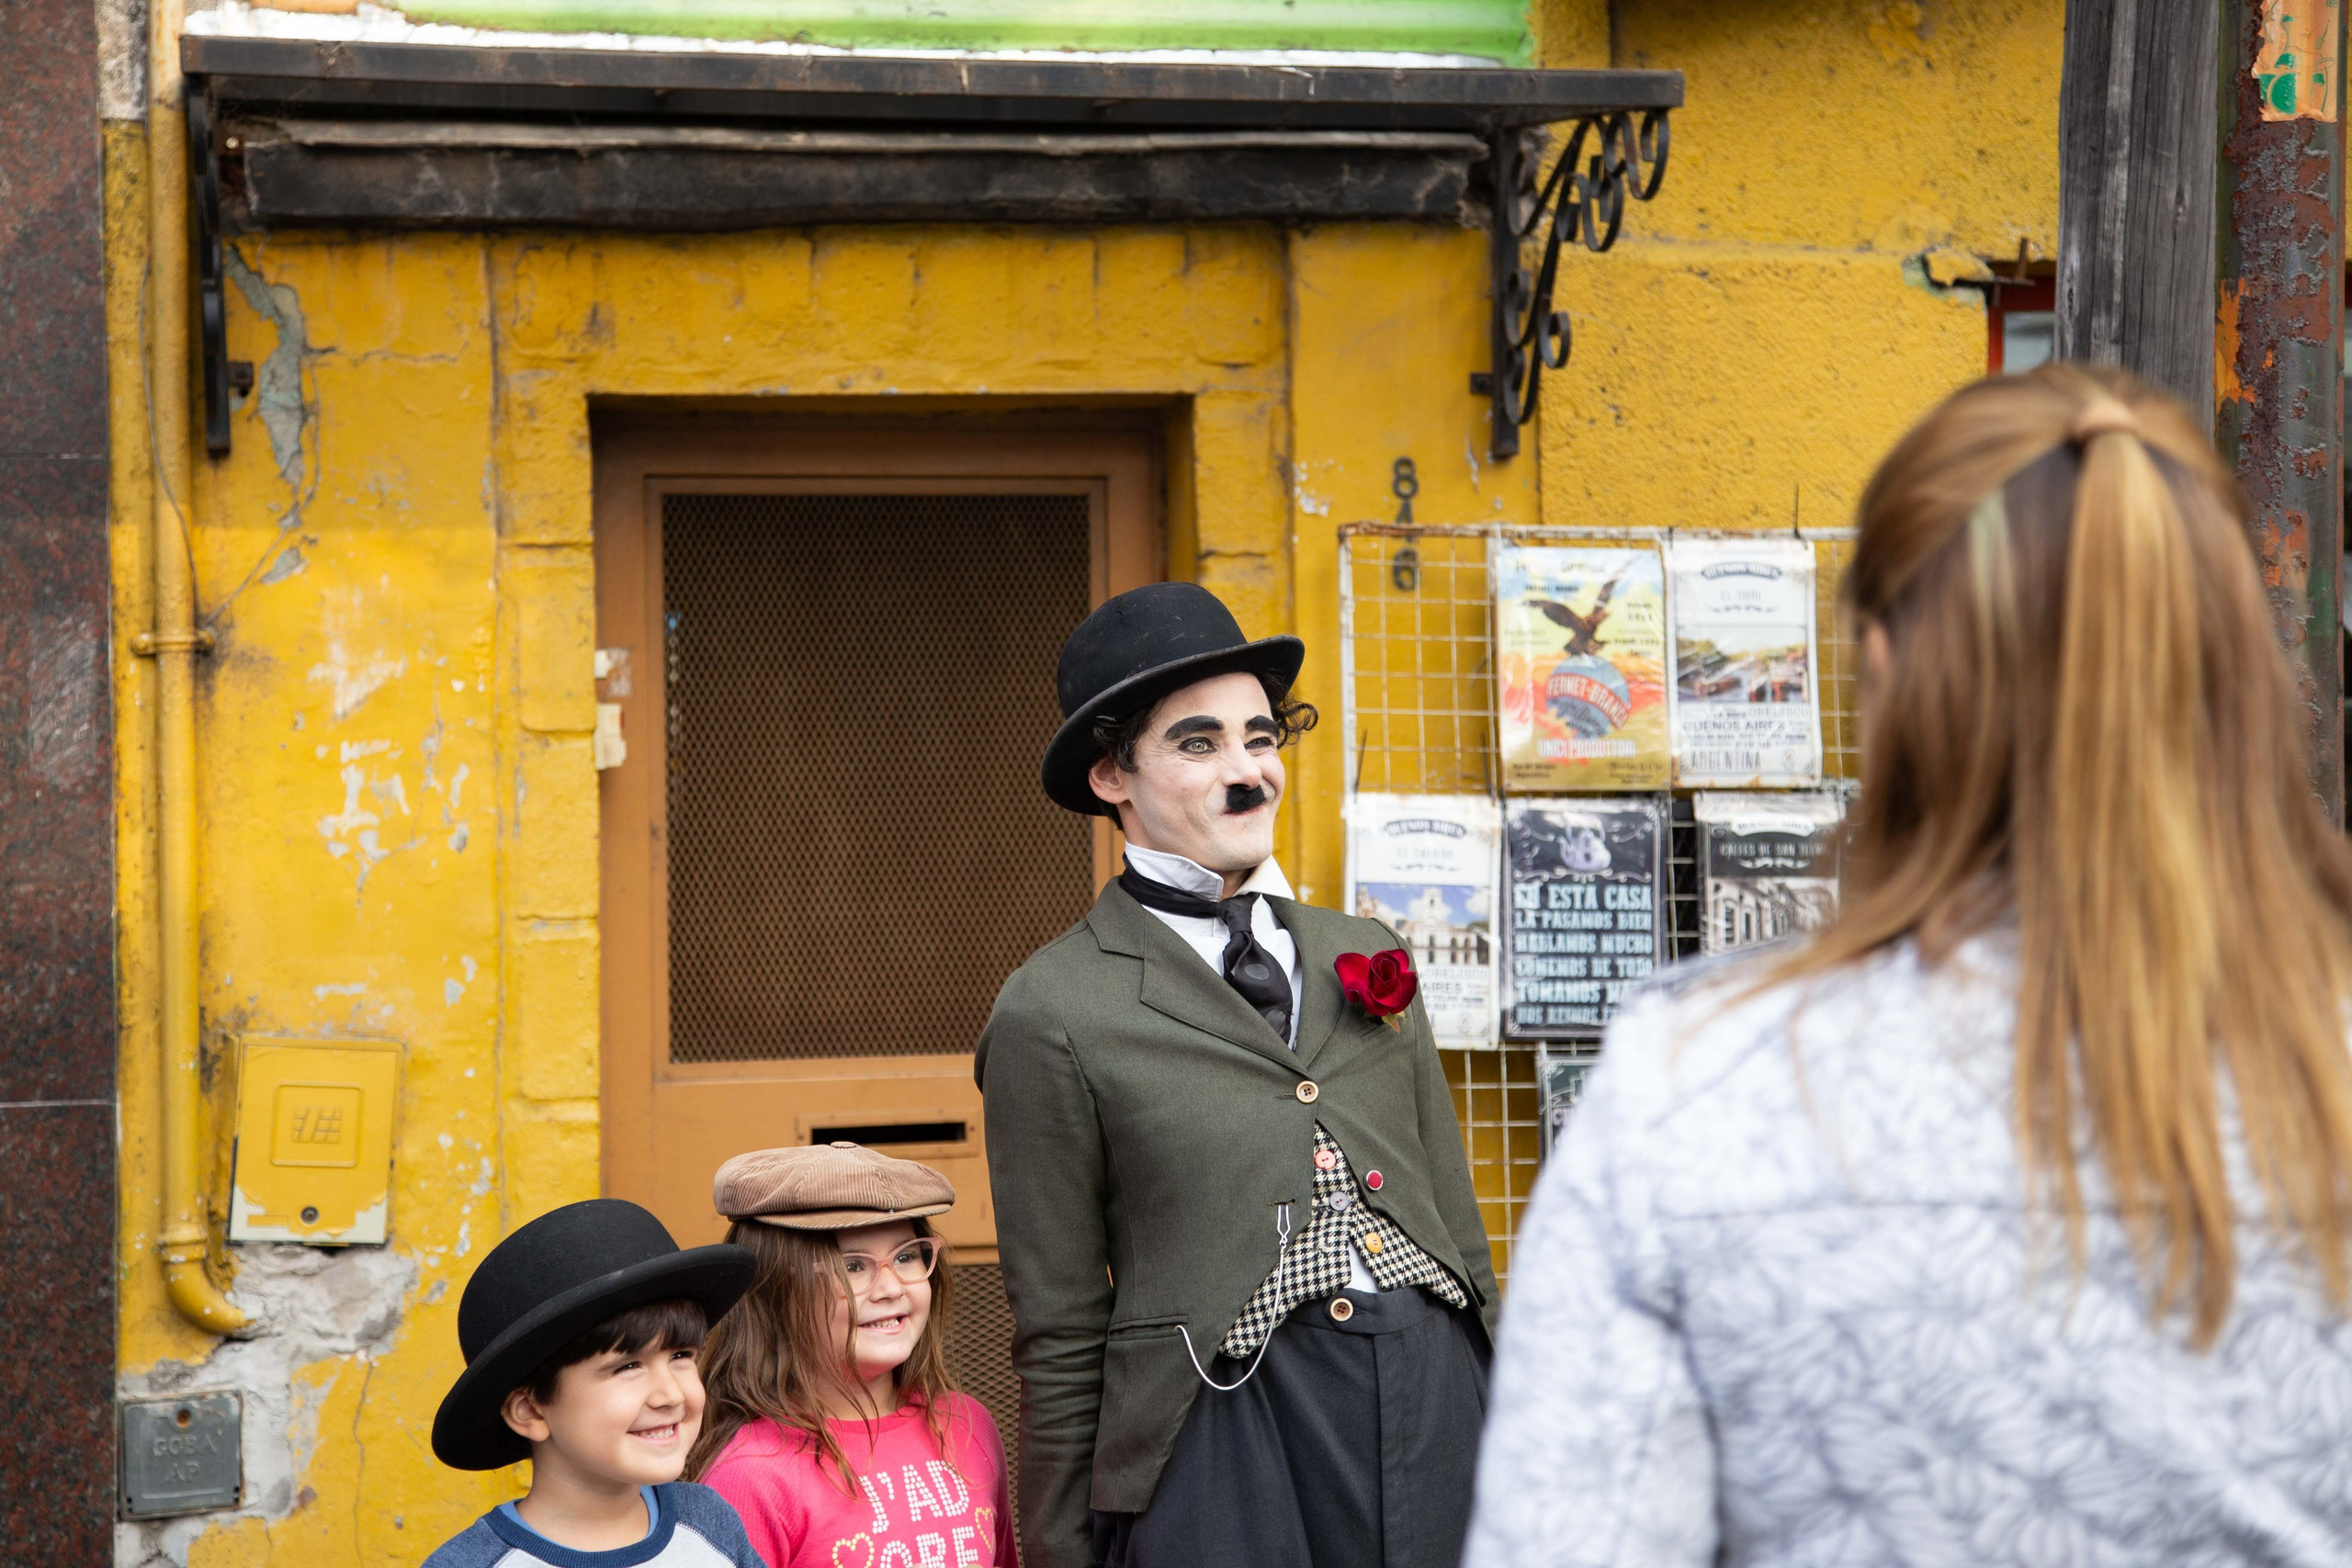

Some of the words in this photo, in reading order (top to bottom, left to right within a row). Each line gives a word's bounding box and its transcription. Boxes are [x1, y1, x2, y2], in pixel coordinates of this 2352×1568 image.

[1548, 675, 1629, 730] FERNET-BRANCA
[1538, 739, 1567, 758] UNICI
[1569, 739, 1635, 759] PRODUTTORI
[1692, 750, 1761, 770] ARGENTINA
[1547, 884, 1599, 910] ESTA
[1603, 885, 1653, 911] CASA
[1515, 910, 1537, 929] LA
[1541, 911, 1613, 930] PASAMOS
[1617, 912, 1653, 931] BIEN
[1516, 932, 1597, 953] HABLAMOS
[1600, 934, 1653, 954] MUCHO
[1516, 957, 1588, 977] COMEMOS
[1590, 957, 1611, 978] DE
[1516, 980, 1600, 1003] TOMAMOS
[858, 1460, 970, 1535] J'AD
